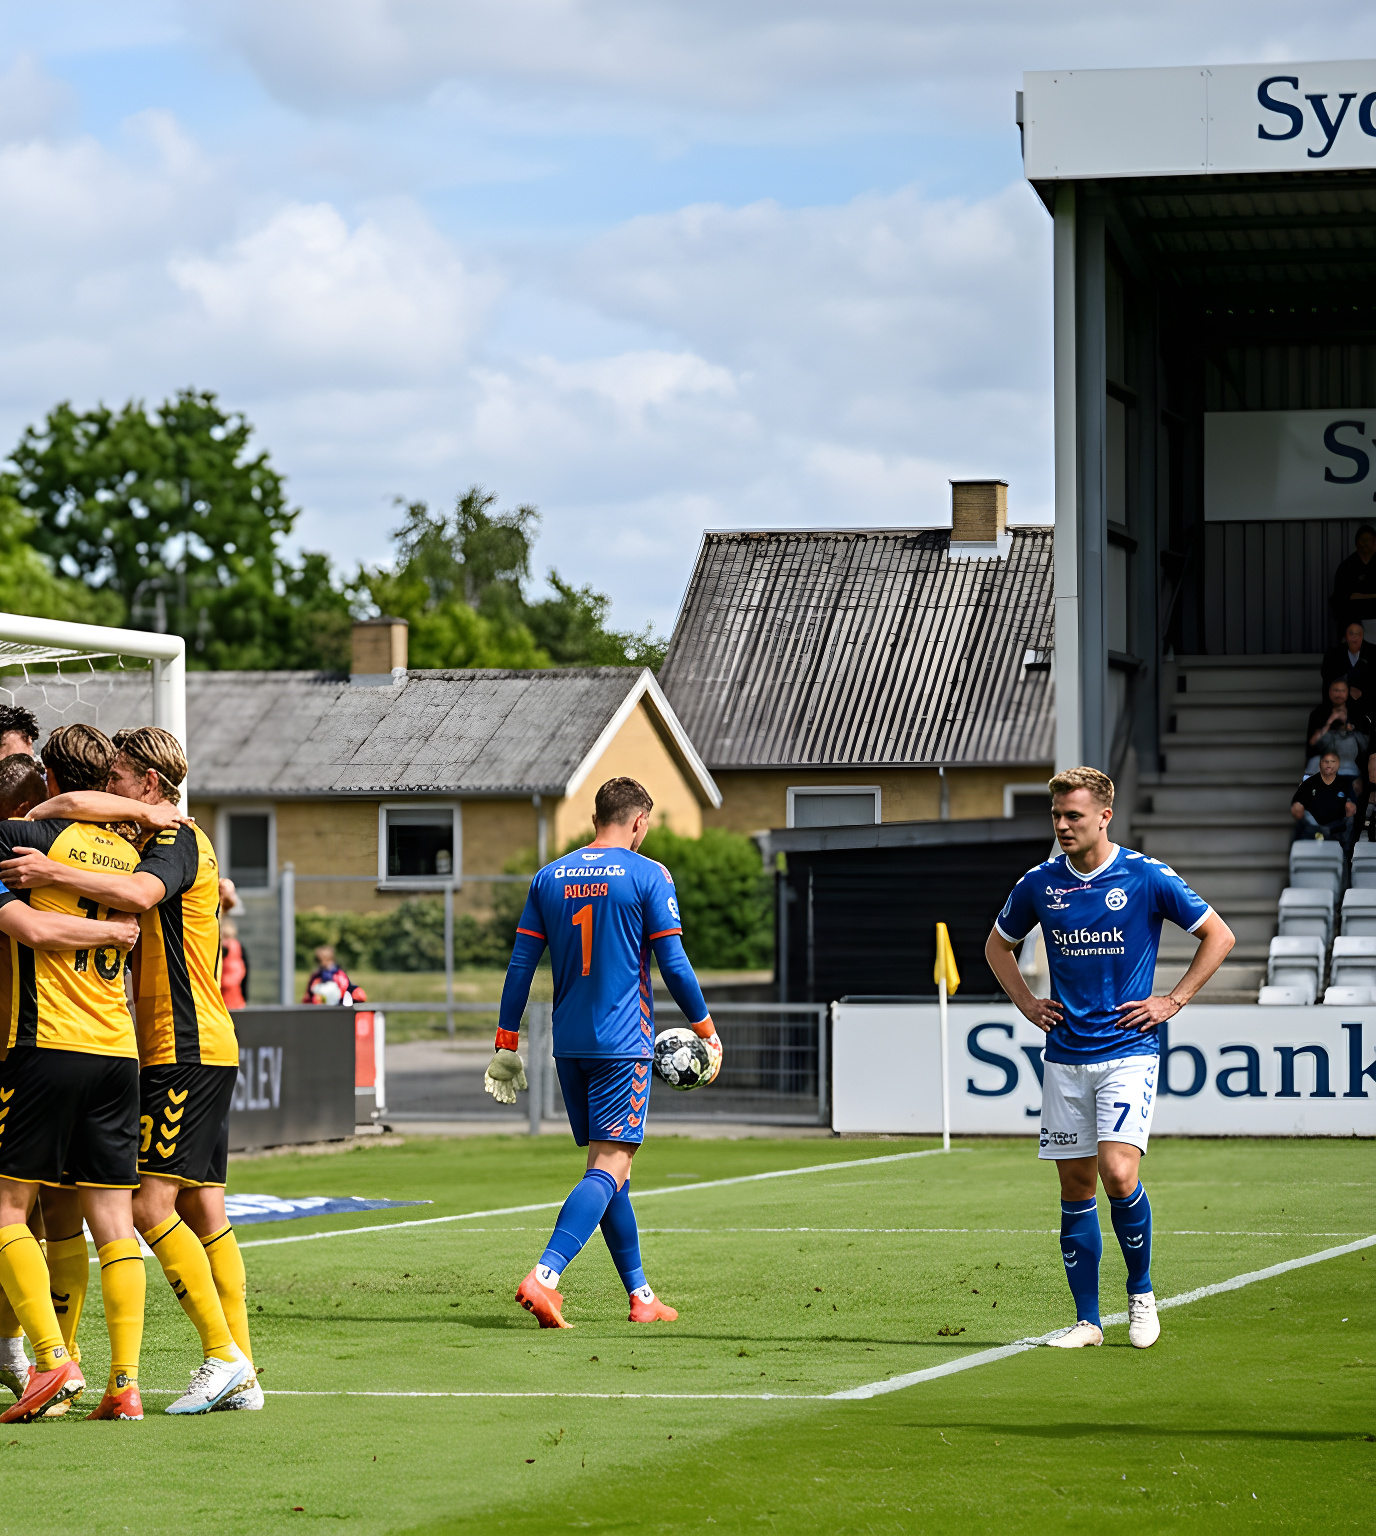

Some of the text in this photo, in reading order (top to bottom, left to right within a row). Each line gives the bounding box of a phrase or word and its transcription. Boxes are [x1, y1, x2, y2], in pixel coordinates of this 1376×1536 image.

[1323, 420, 1376, 485] S
[572, 904, 593, 976] 1
[967, 1022, 1376, 1117] Sbank
[1113, 1101, 1131, 1133] 7
